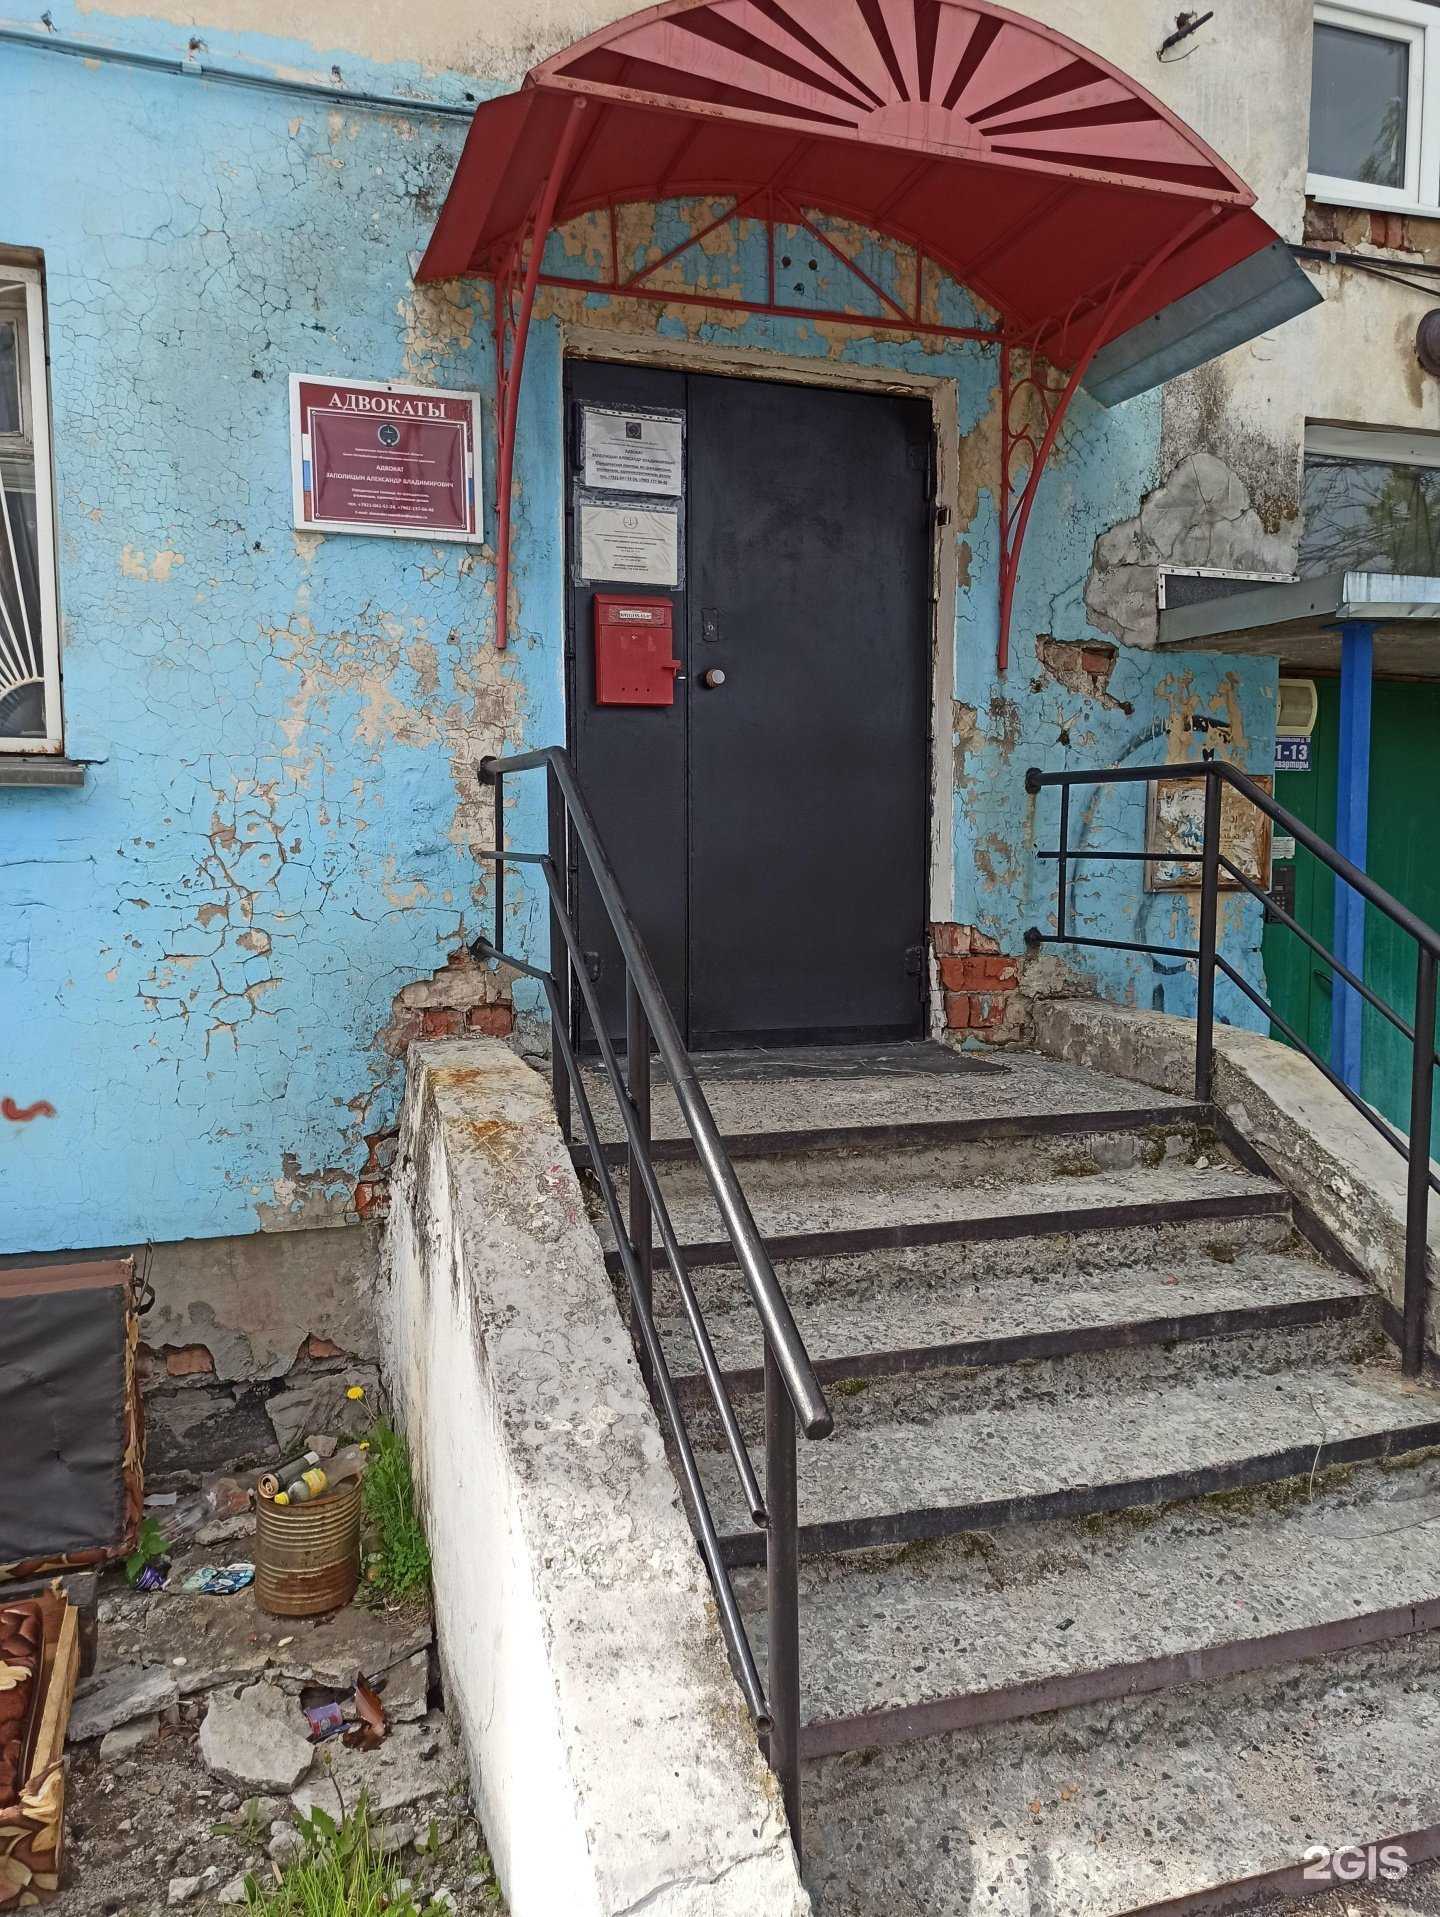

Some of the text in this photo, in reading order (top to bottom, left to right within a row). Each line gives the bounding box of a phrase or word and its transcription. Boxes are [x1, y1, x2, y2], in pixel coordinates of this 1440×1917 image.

[329, 392, 446, 418] АДВОКАТЫ
[366, 476, 402, 484] АЛЕКСАНДР
[403, 478, 454, 488] ВЛАДИМИРОВИЧ
